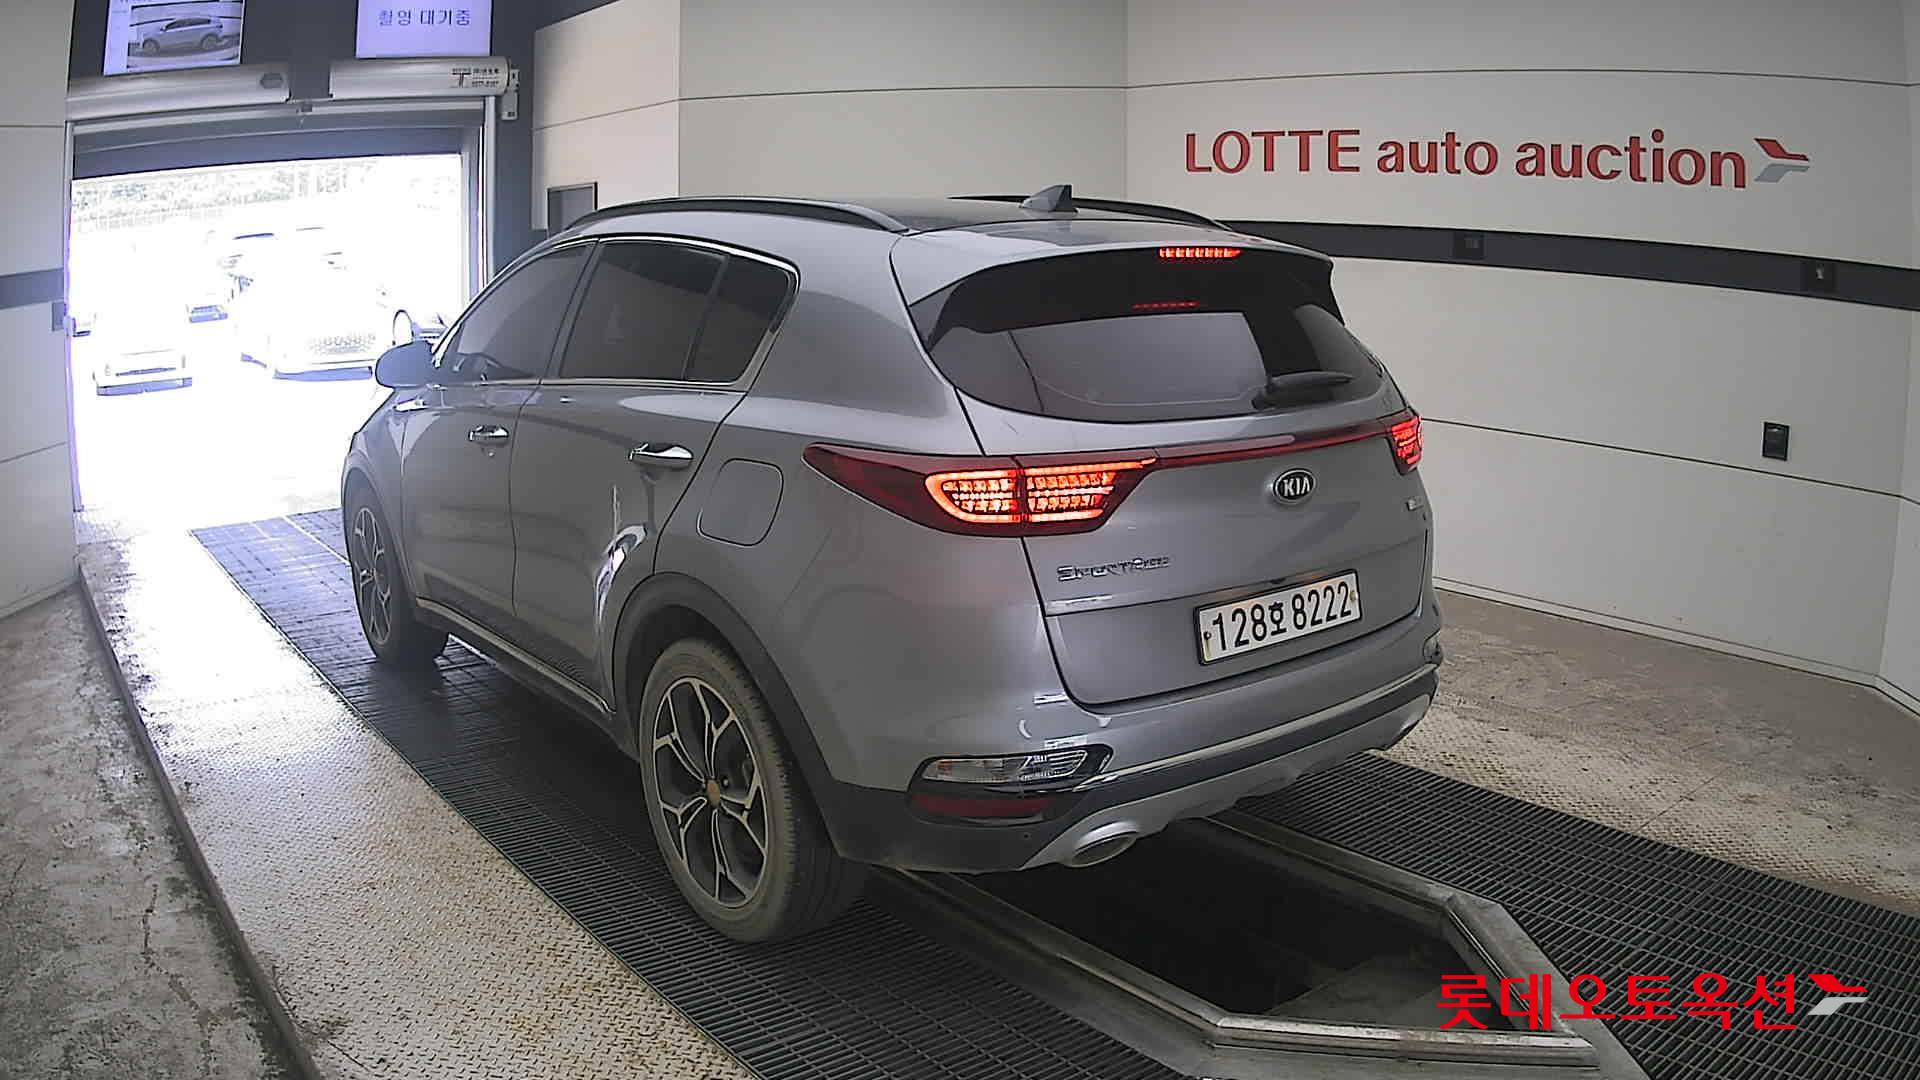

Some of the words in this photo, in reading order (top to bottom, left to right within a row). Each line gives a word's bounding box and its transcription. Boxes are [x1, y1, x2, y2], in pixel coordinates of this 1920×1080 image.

[420, 9, 470, 26] 대기중
[1186, 130, 1360, 173] LOTTE
[1377, 132, 1498, 175] auto
[1515, 129, 1746, 188] auction
[1282, 475, 1310, 497] KIA
